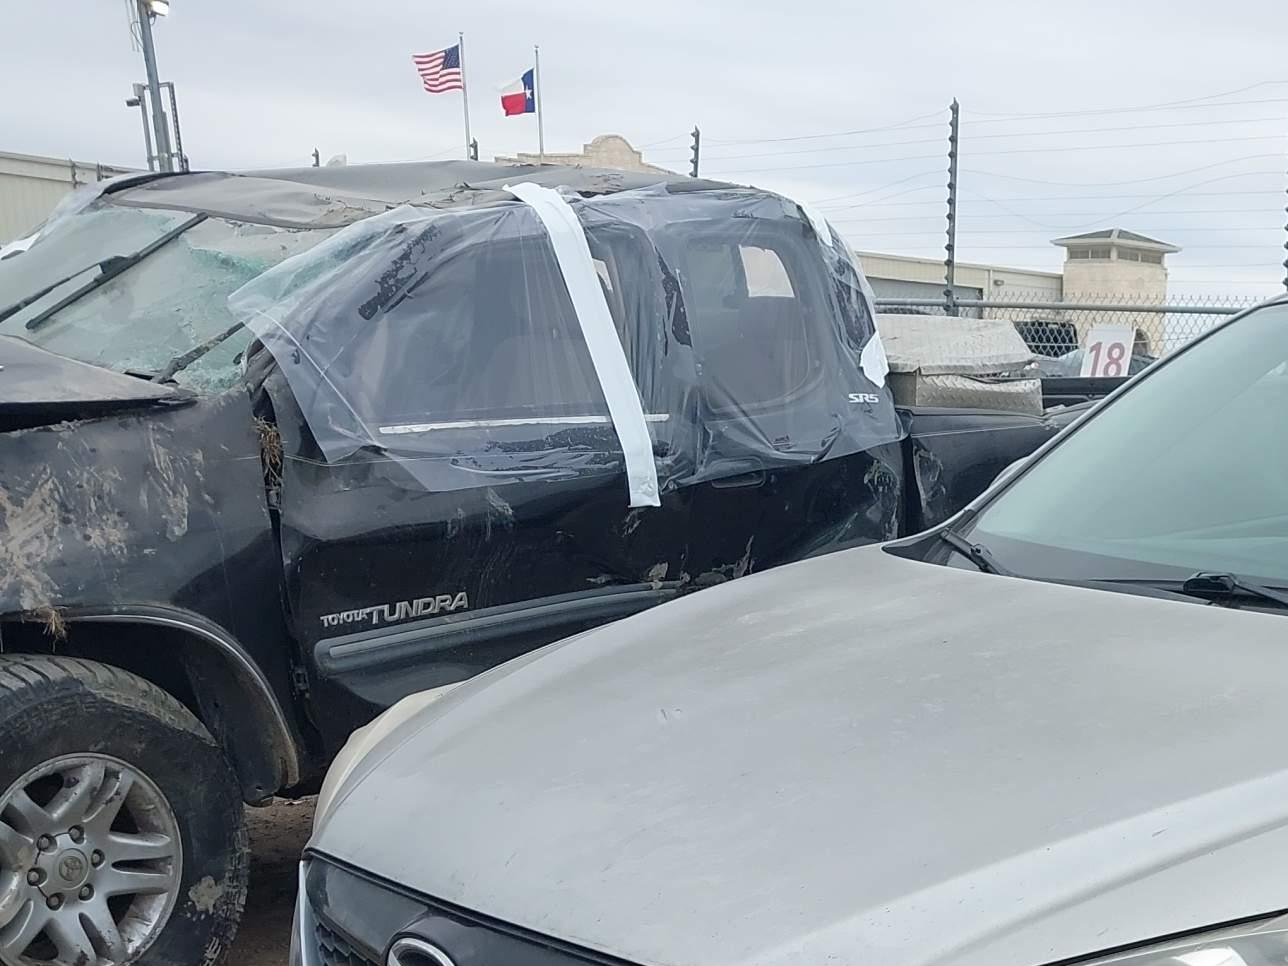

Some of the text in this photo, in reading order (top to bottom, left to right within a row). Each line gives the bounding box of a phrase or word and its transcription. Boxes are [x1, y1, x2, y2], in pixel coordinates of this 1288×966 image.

[1089, 341, 1126, 377] 18
[847, 393, 880, 404] SR5
[320, 591, 469, 628] TOYOTA TUNDRA
